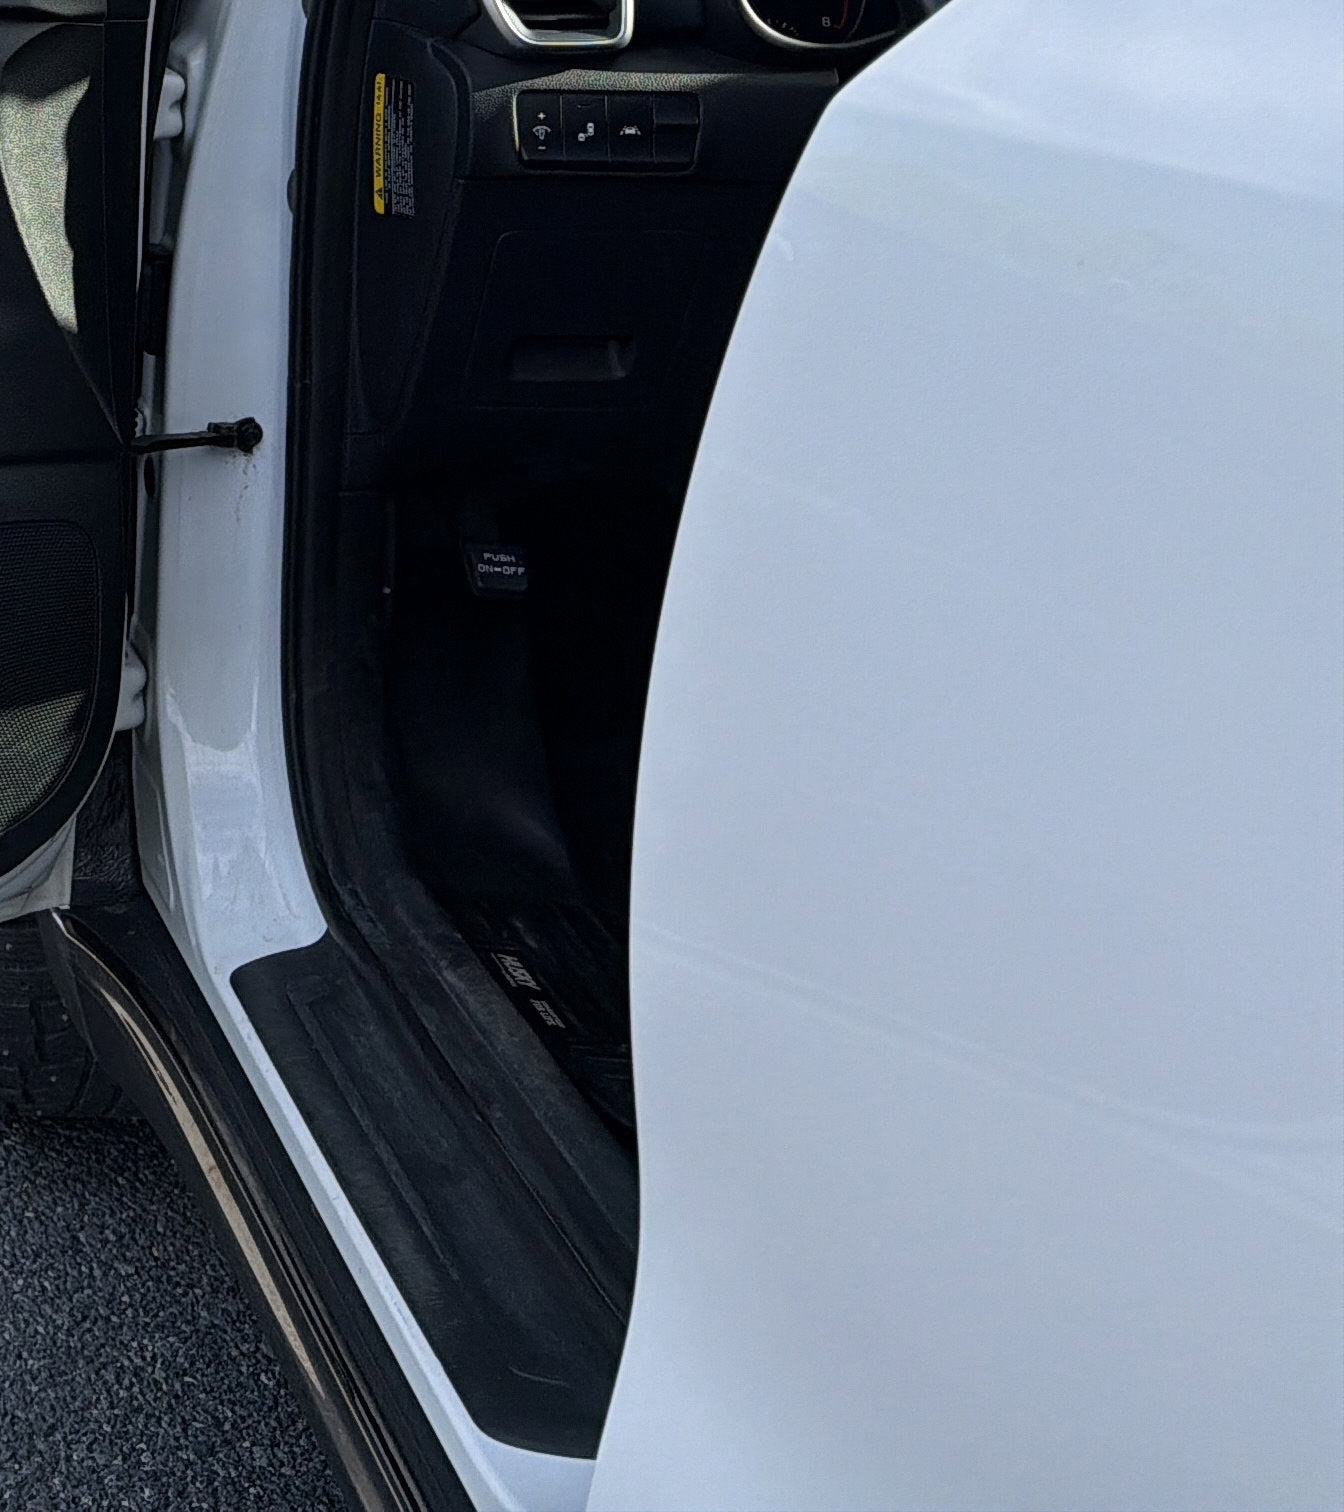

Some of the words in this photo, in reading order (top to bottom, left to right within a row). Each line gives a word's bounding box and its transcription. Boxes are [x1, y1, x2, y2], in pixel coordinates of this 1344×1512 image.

[821, 16, 831, 28] 8
[483, 552, 516, 563] PUSH
[477, 563, 526, 576] ON-OFF
